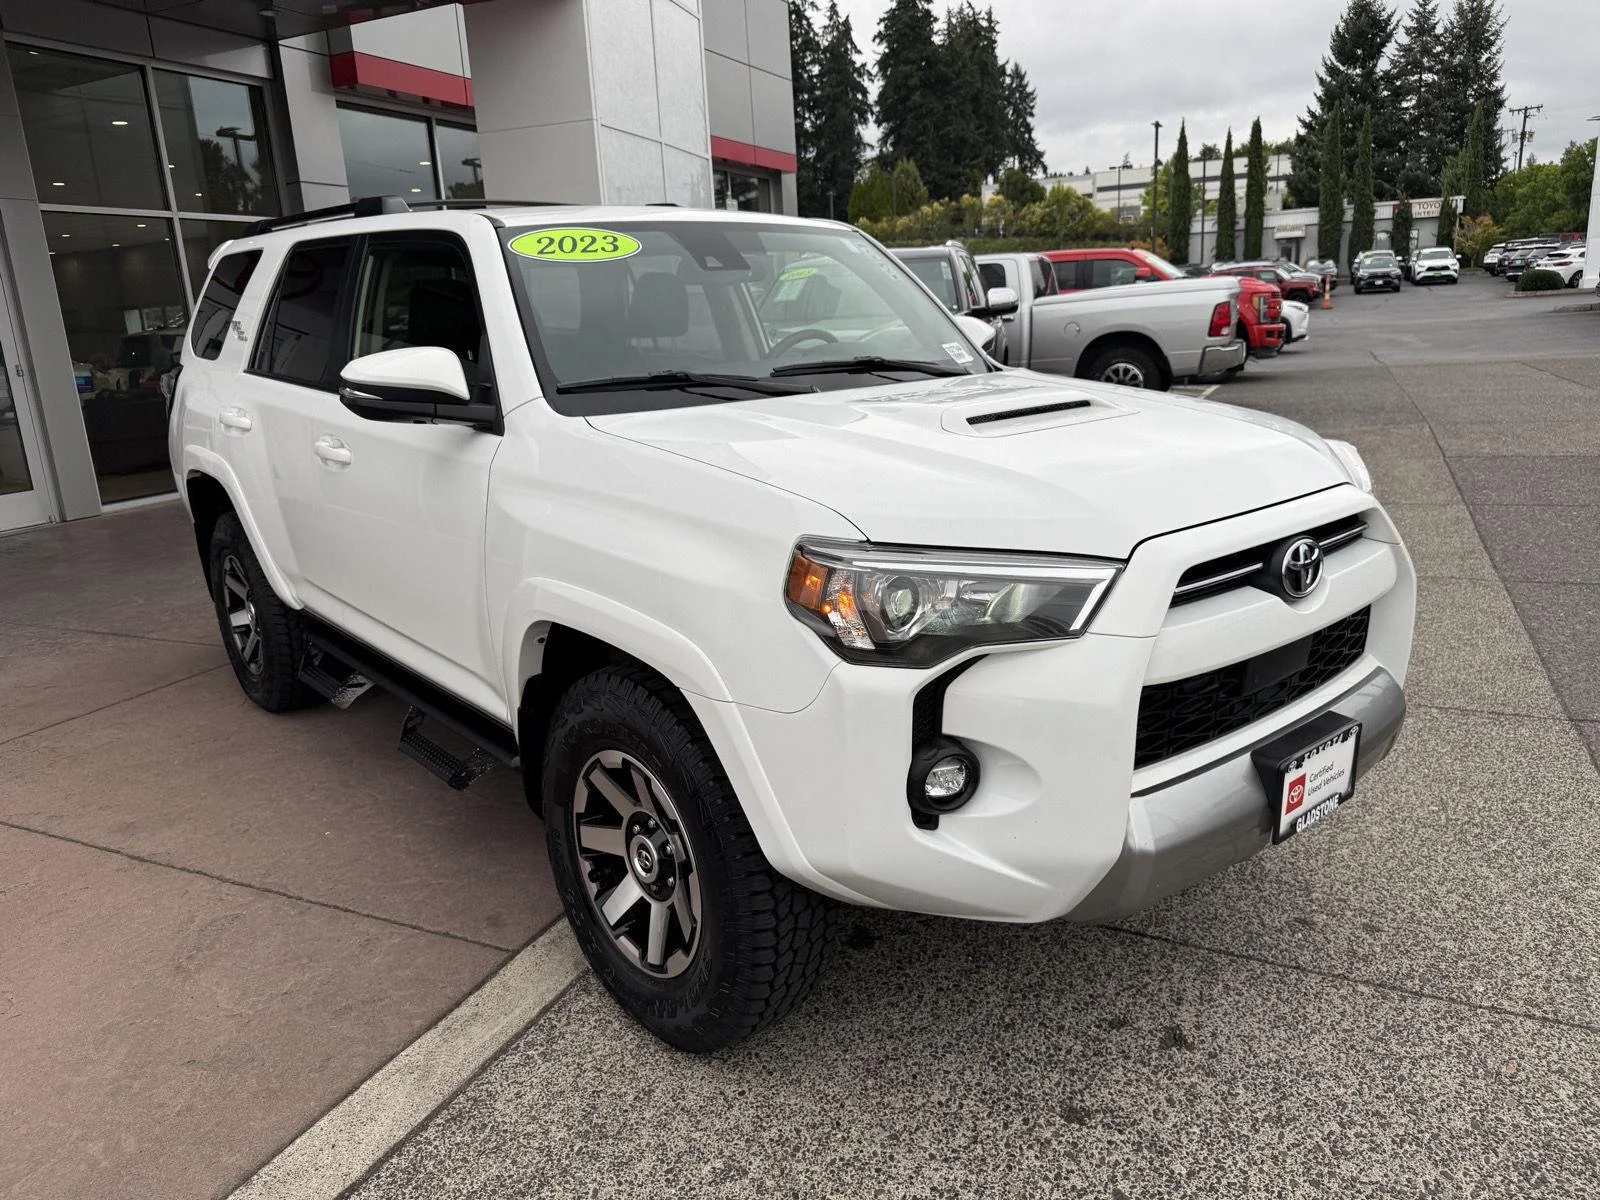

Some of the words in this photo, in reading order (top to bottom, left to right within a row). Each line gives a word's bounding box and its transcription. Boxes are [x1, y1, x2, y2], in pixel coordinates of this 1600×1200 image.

[1418, 201, 1441, 210] TOYO
[536, 235, 620, 255] 2023
[1308, 780, 1323, 796] Used
[1323, 768, 1345, 787] Vehicles
[1309, 761, 1334, 783] Certified
[1296, 794, 1340, 833] GLADSTONE
